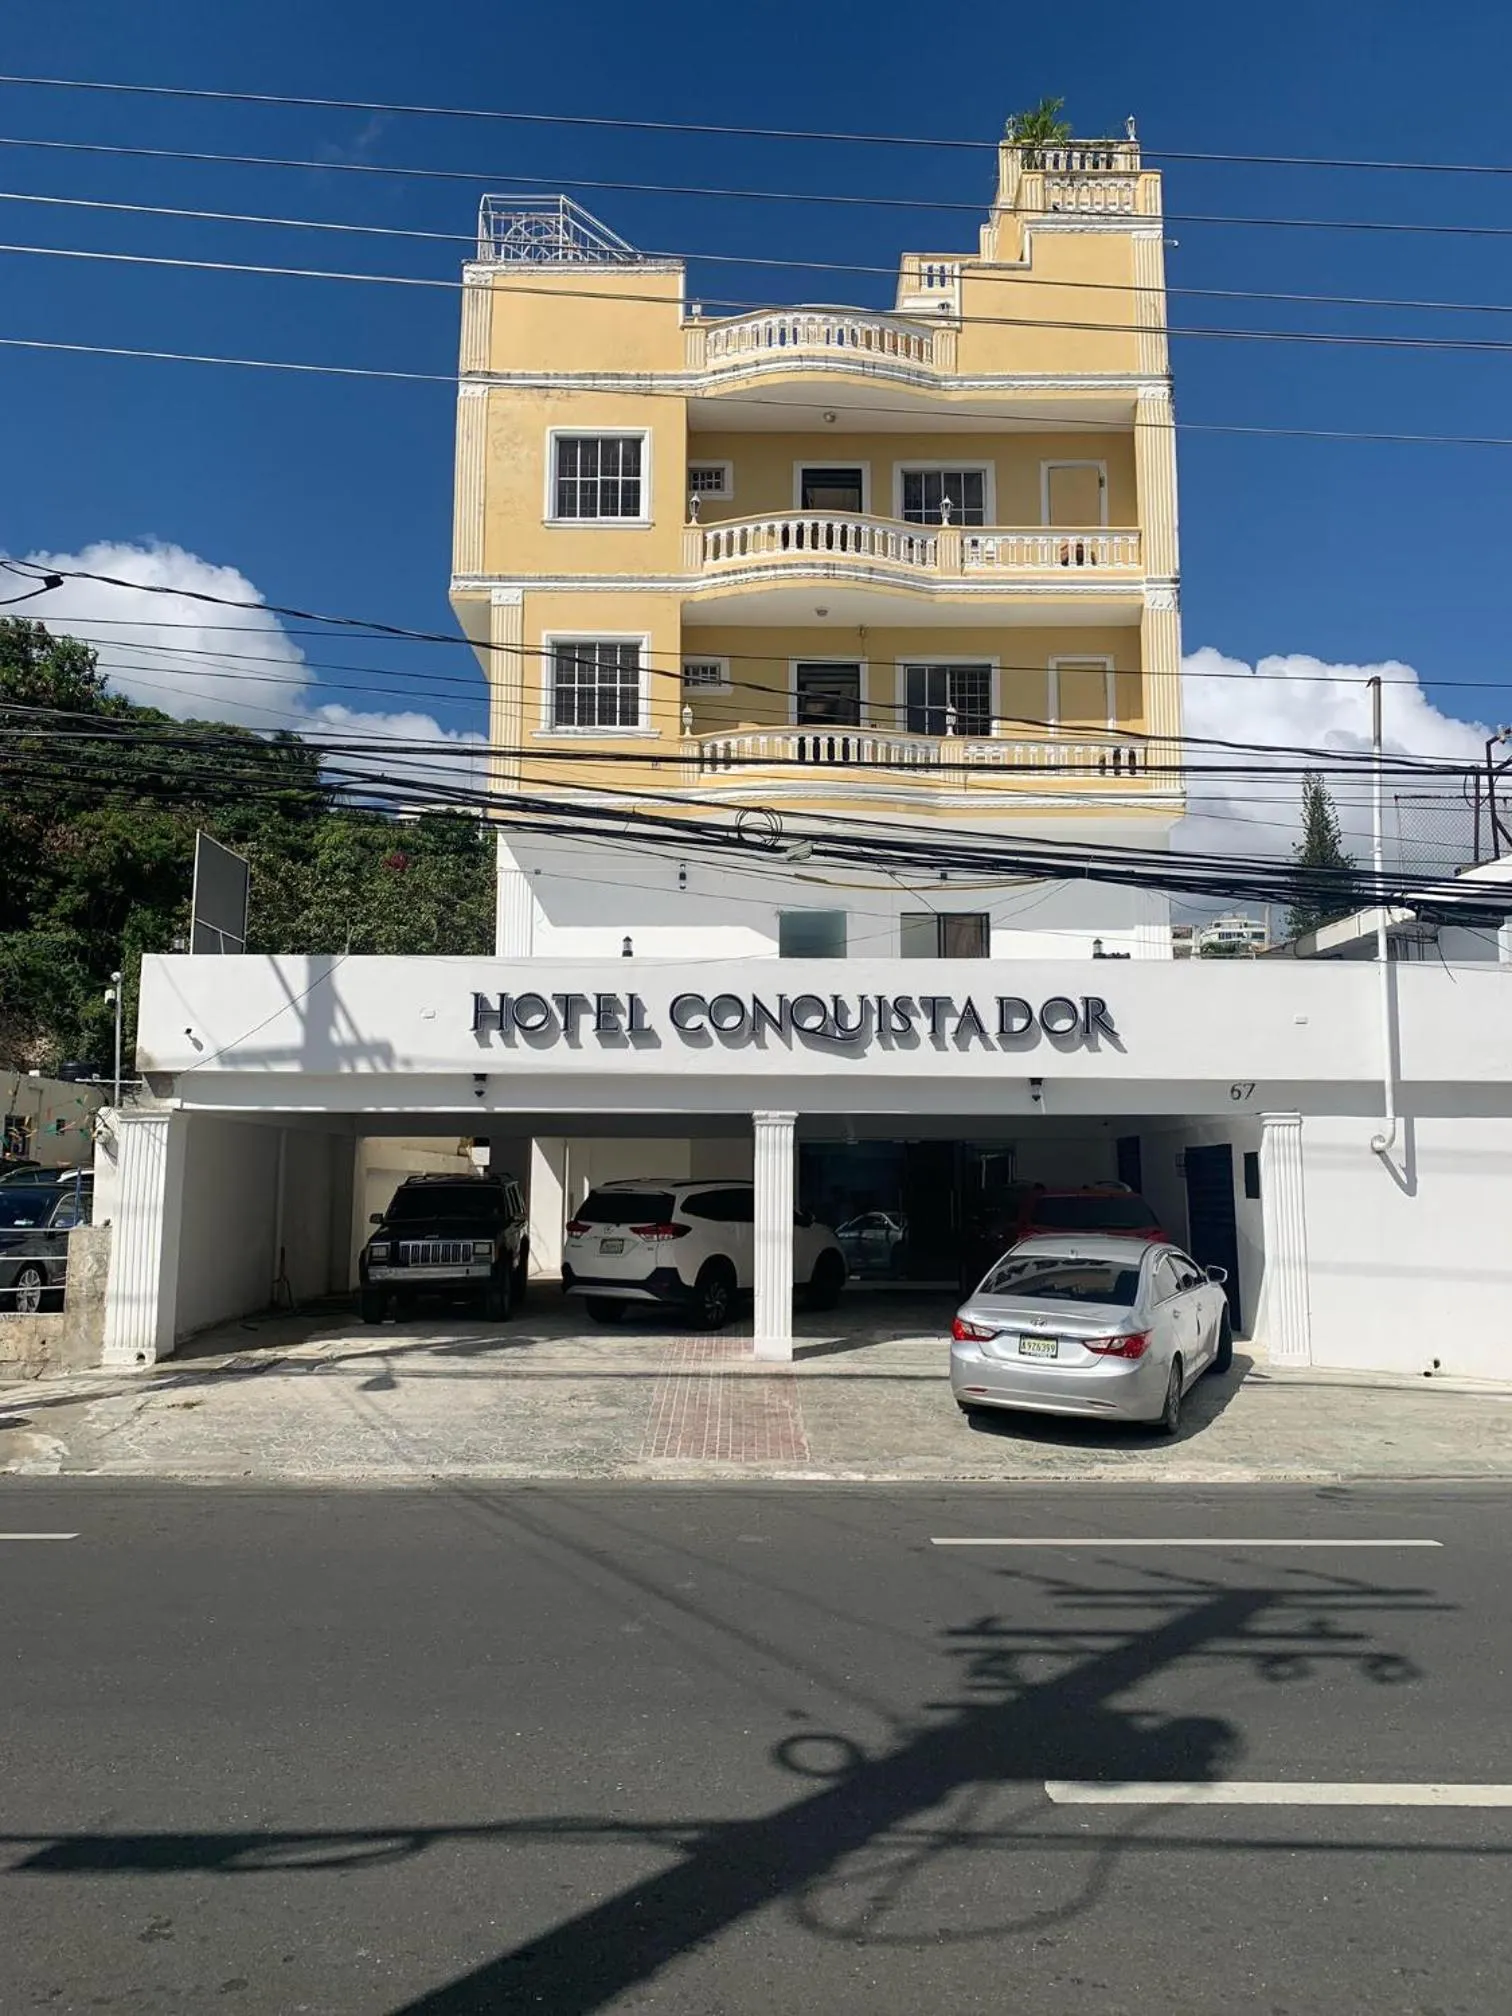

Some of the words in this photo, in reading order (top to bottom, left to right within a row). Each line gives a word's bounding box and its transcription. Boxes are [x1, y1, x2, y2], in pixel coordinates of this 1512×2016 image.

[470, 991, 653, 1034] HOTEL
[668, 992, 1120, 1042] CONQUISTADOR
[1230, 1082, 1256, 1101] 67
